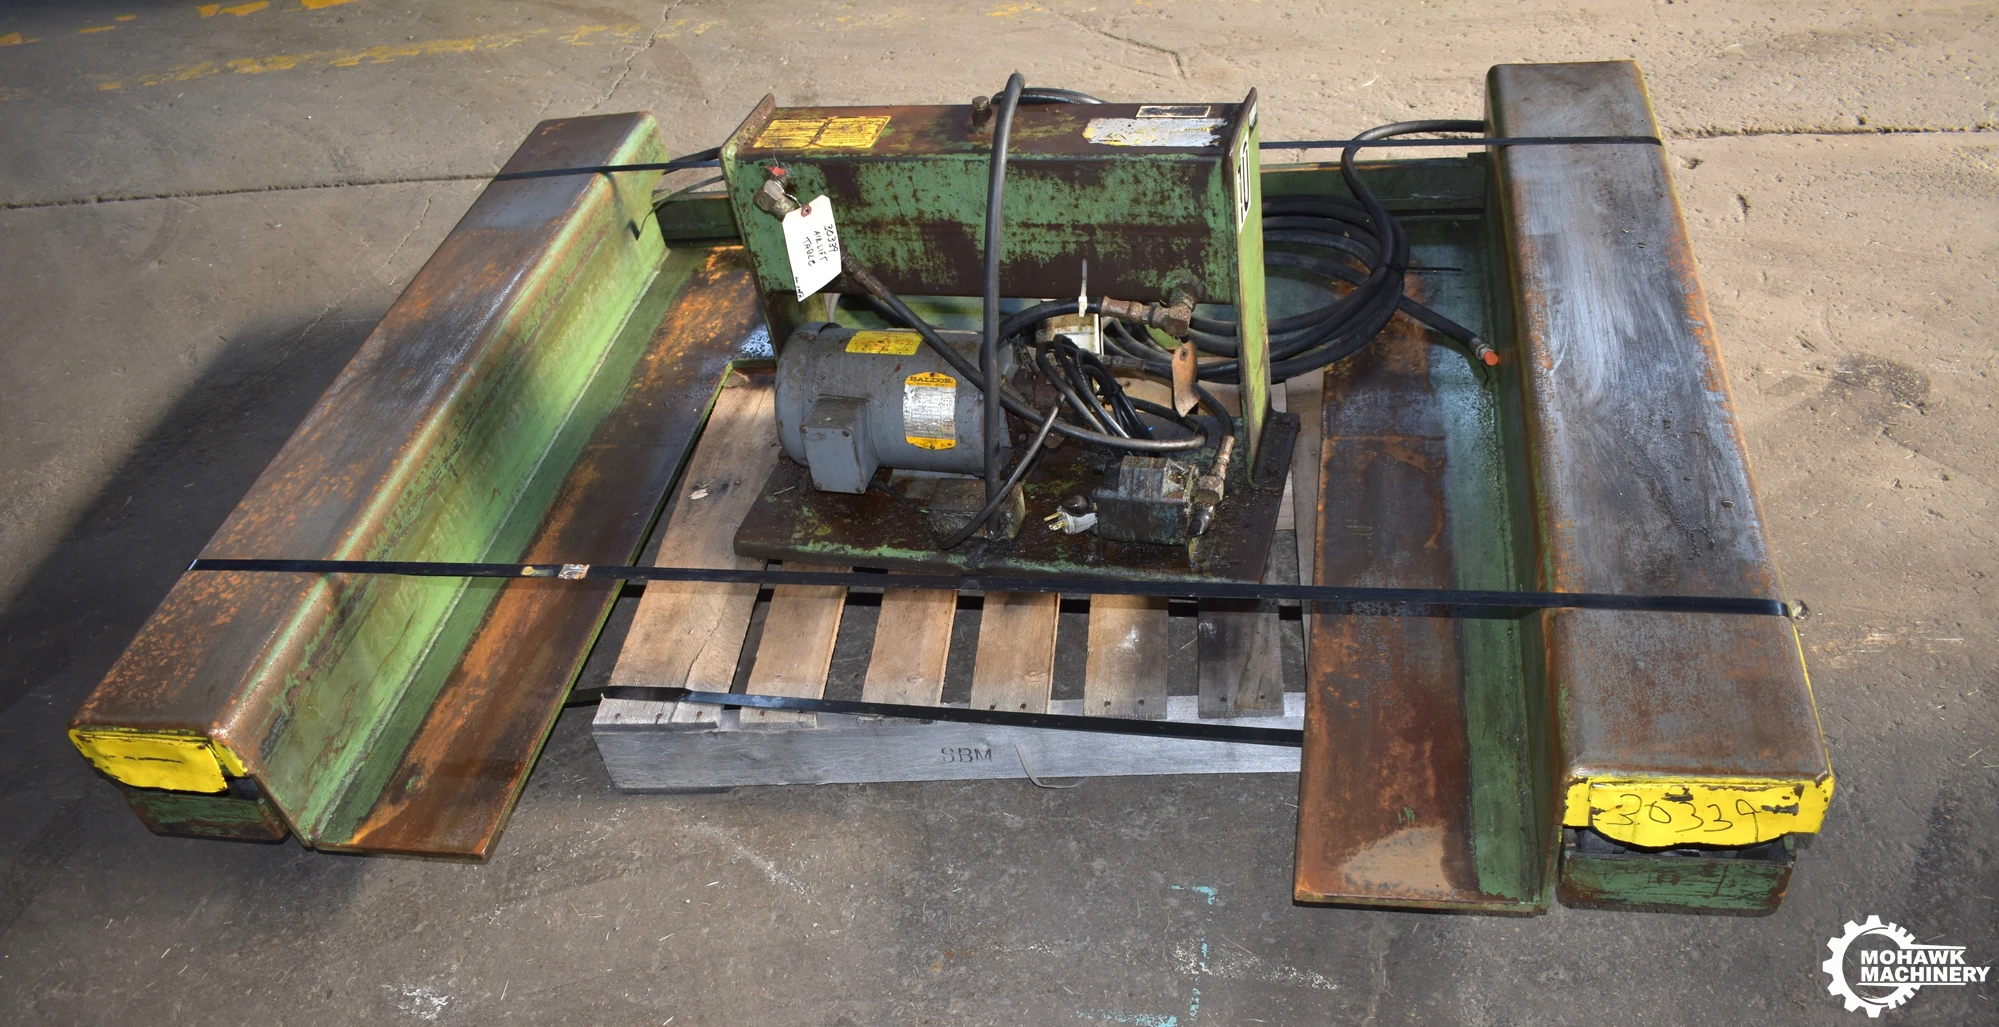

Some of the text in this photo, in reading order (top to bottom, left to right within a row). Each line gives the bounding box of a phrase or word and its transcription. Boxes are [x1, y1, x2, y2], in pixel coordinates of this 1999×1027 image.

[824, 223, 839, 253] 30339
[909, 376, 953, 384] BALDOR
[941, 746, 992, 763] SBM
[1606, 793, 1764, 843] 30339
